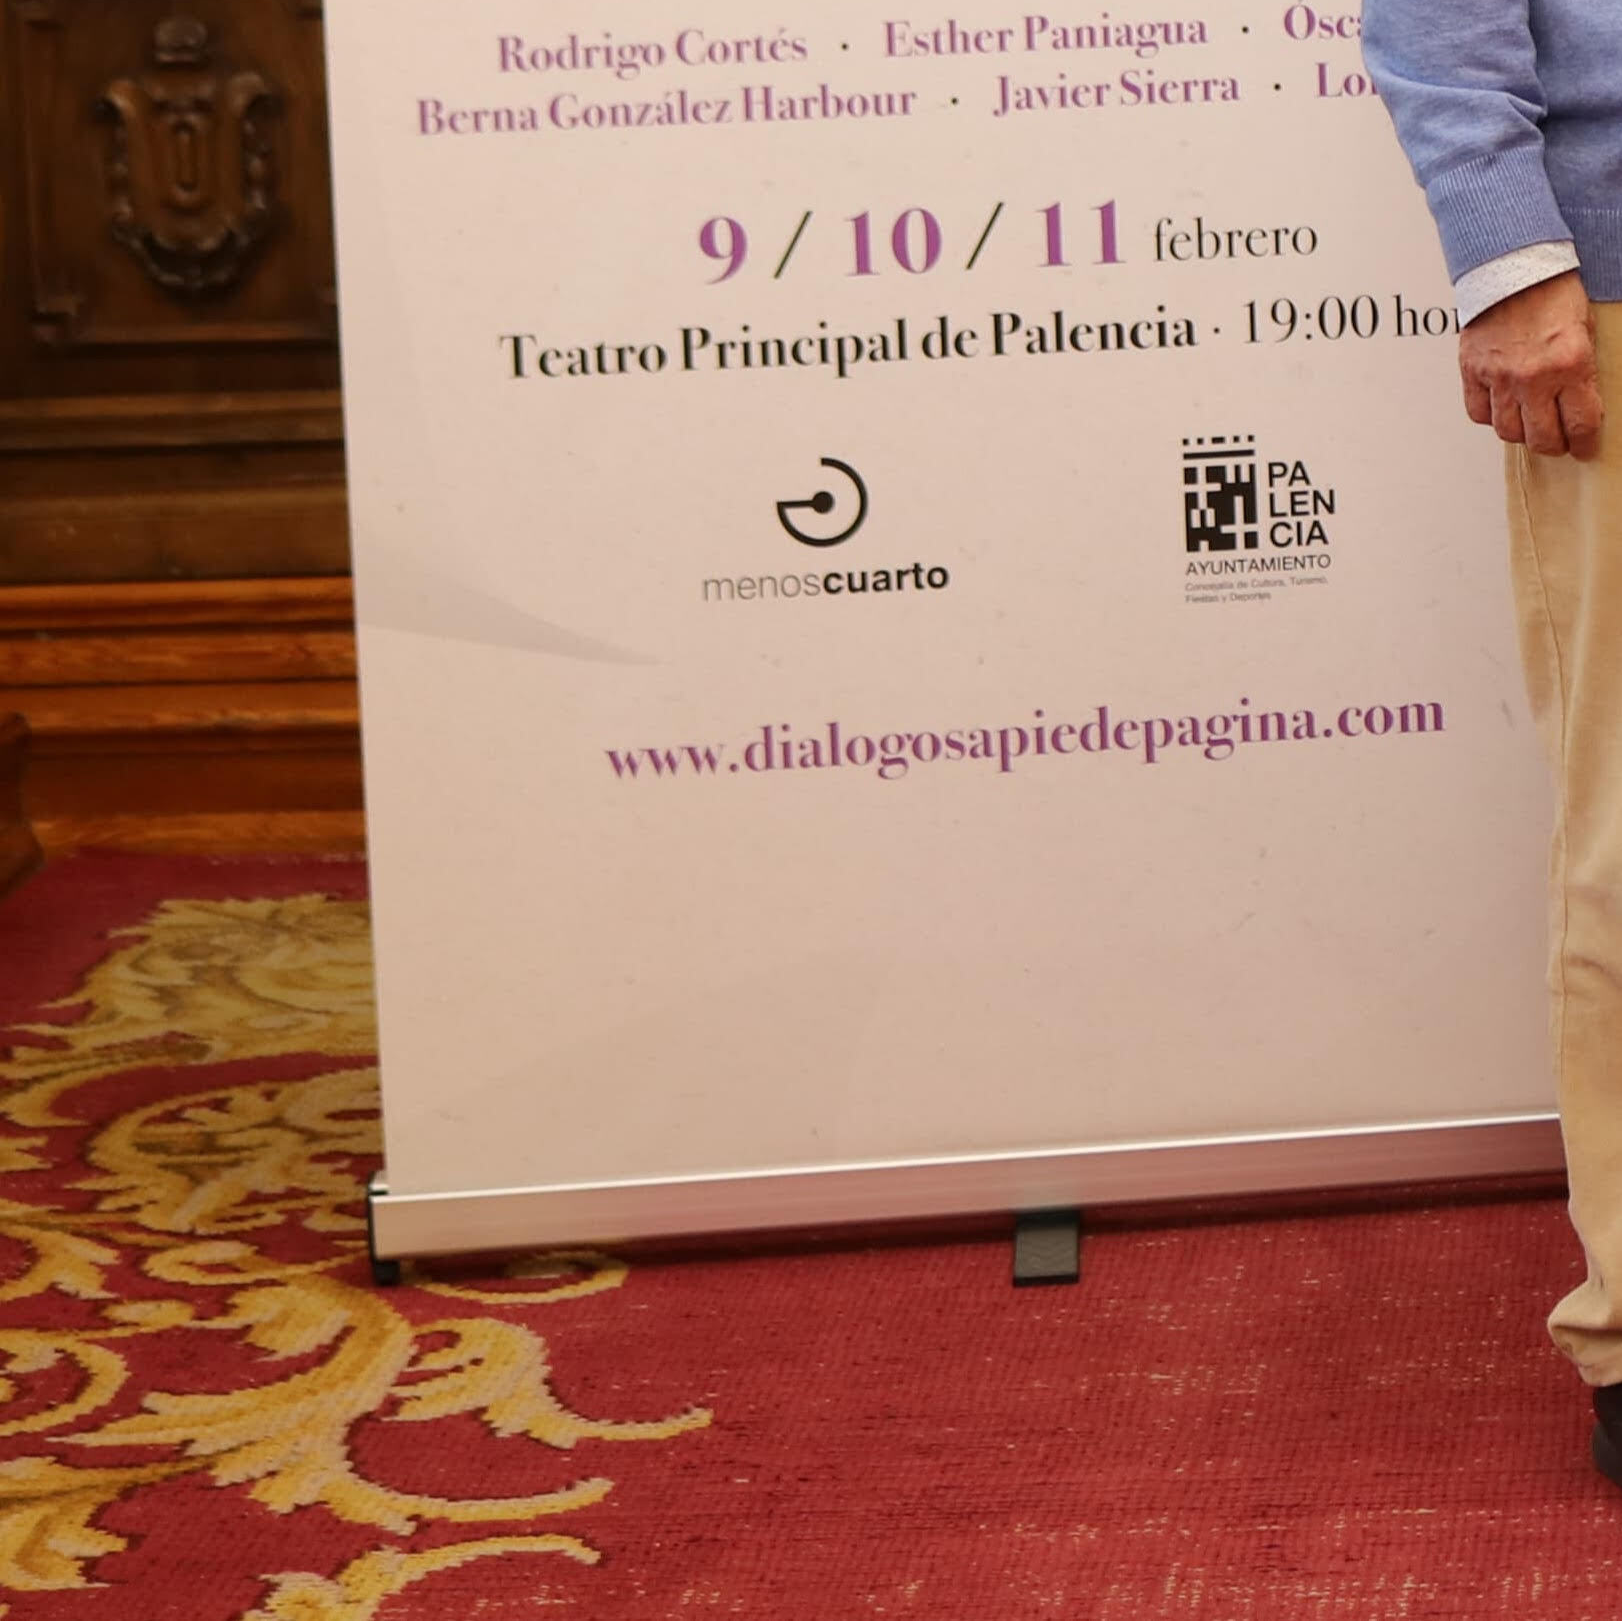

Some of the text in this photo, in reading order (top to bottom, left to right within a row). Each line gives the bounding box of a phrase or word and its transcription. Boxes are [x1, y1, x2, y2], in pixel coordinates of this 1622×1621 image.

[498, 32, 666, 80] Rodrigo
[674, 29, 808, 65] Cortés
[885, 18, 1014, 57] Esther
[1024, 12, 1207, 59] Paniagua
[417, 99, 538, 136] Berna
[548, 89, 731, 129] González
[742, 83, 917, 122] Harbour
[992, 73, 1111, 117] Javier
[1120, 69, 1239, 105] Sierra
[698, 217, 748, 284] 9
[844, 207, 943, 277] 10
[1036, 198, 1127, 268] 11
[1155, 216, 1318, 262] febrero
[498, 334, 668, 379] Teatro
[681, 318, 908, 379] Principal
[921, 315, 977, 359] de
[992, 304, 1196, 356] Palencia
[1242, 294, 1380, 344] 19:00
[1268, 461, 1310, 487] PA
[1269, 489, 1336, 518] LEN
[1270, 520, 1328, 547] CIA
[701, 561, 950, 602] menoscuarto
[1184, 554, 1332, 577] AYUNTAMIENTO
[605, 697, 1445, 780] www.dialogosapiedepagina.com
